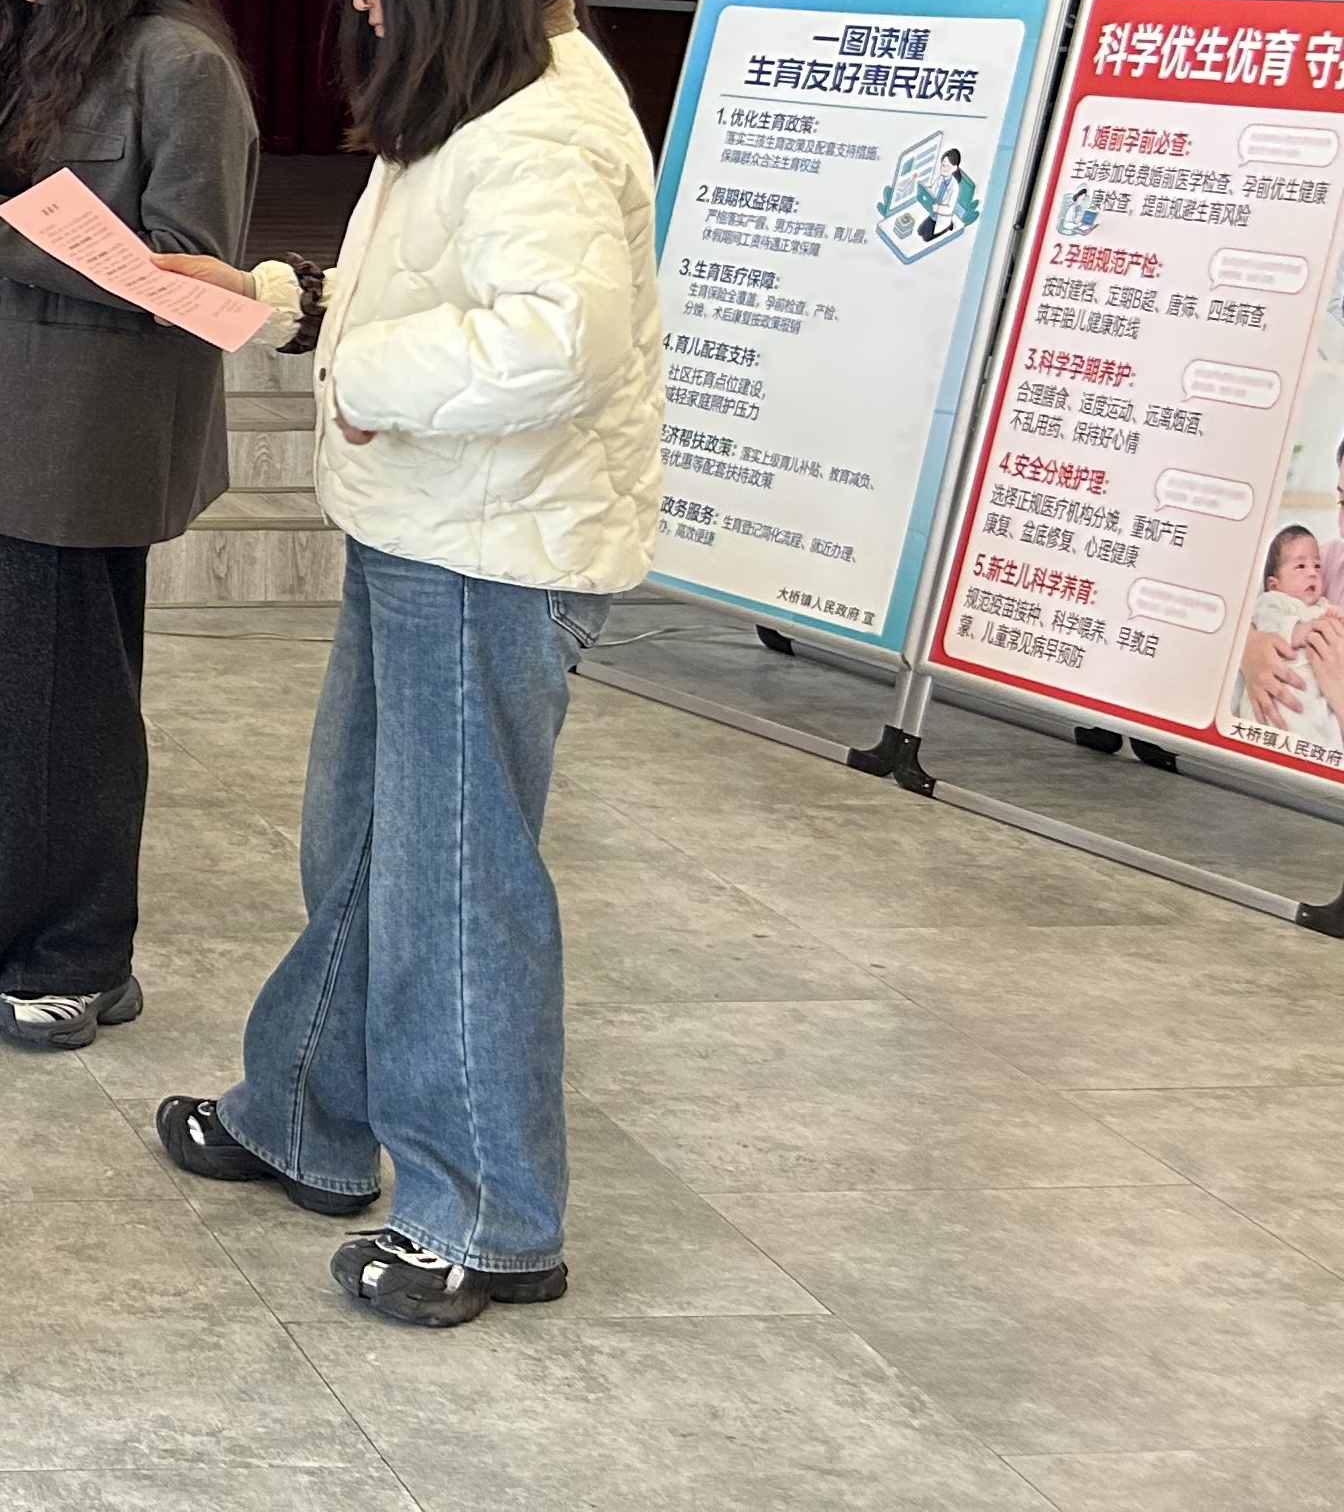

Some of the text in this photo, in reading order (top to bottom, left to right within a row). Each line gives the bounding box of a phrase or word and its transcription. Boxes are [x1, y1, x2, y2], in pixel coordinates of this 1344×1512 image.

[811, 24, 931, 61] 一图读懂
[1092, 22, 1344, 90] 科学优生优育 守
[743, 55, 979, 103] 生育友好惠民政策
[720, 148, 822, 175] 保障群众合法生育权益
[702, 227, 822, 257] 休假期间工资待遇正常保障
[1035, 303, 1141, 340] 筑牢胎儿健康防线
[668, 363, 766, 400] 社区托育点位建设，
[1010, 407, 1141, 455] 不乱用药、保持好心情
[1016, 380, 1206, 437] 合理膳食、适度运动、远离烟酒、
[989, 483, 1189, 548] 选择正规医疗机构分娩，重视产后
[981, 511, 1141, 569] 康复、盆底修复、心理健康
[776, 587, 876, 626] 大桥镇人民政府 宣
[962, 585, 1160, 658] 规范疫苗接种、科学喂养、早教启
[956, 614, 1087, 670] 蒙、儿童常见病早预防
[1229, 722, 1343, 767] 大桥镇人民政府
